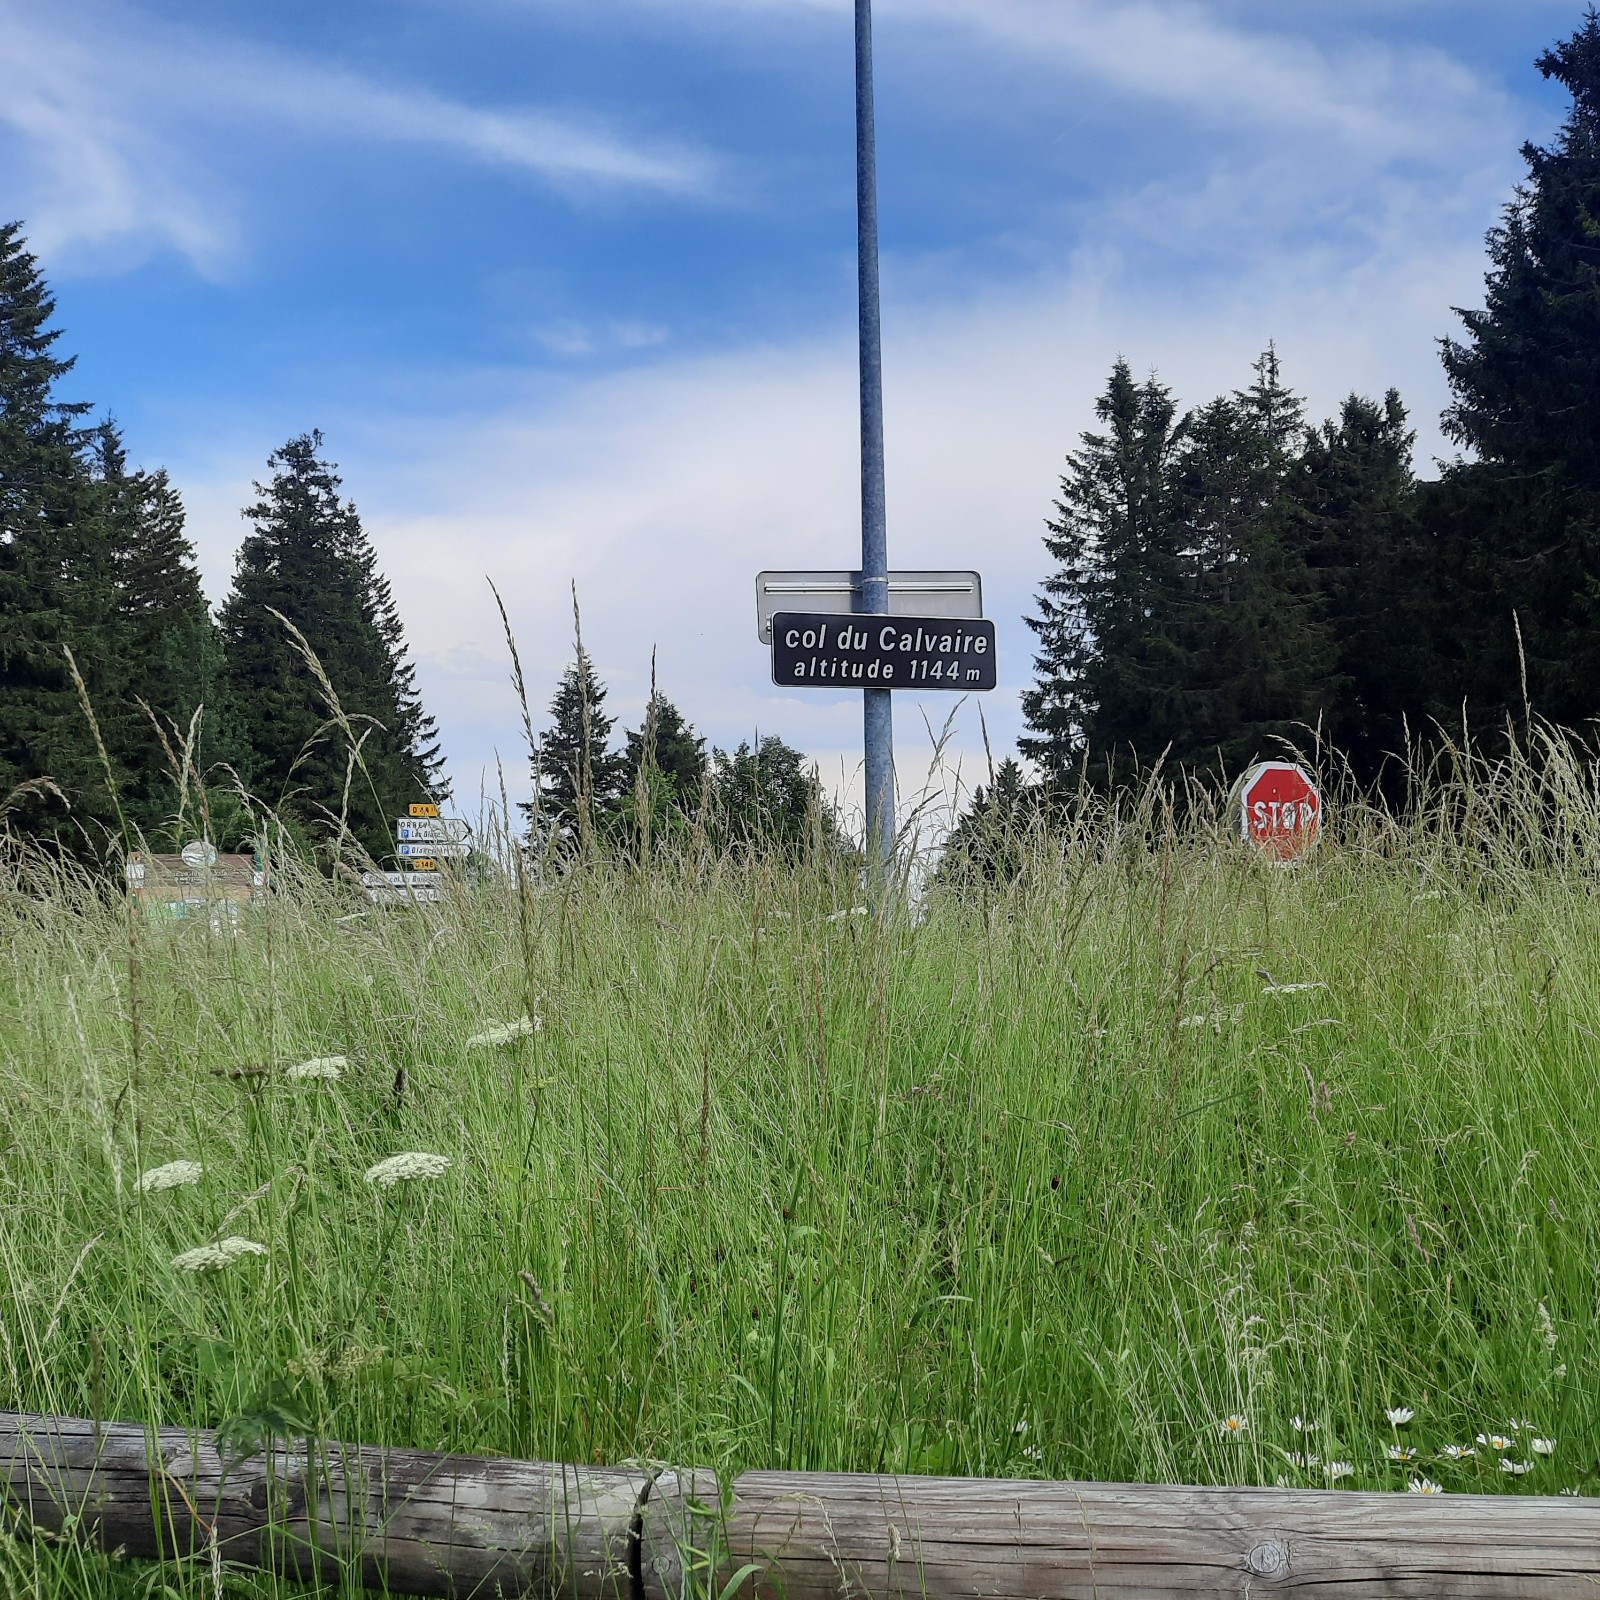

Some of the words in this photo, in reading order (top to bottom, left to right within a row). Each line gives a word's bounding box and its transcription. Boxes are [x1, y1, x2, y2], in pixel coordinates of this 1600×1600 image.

[785, 624, 827, 649] col
[837, 625, 869, 651] du
[879, 626, 988, 654] Calvaire
[794, 657, 894, 679] altitude
[910, 659, 960, 681] 1144
[966, 668, 981, 681] m
[1254, 801, 1314, 830] STOP
